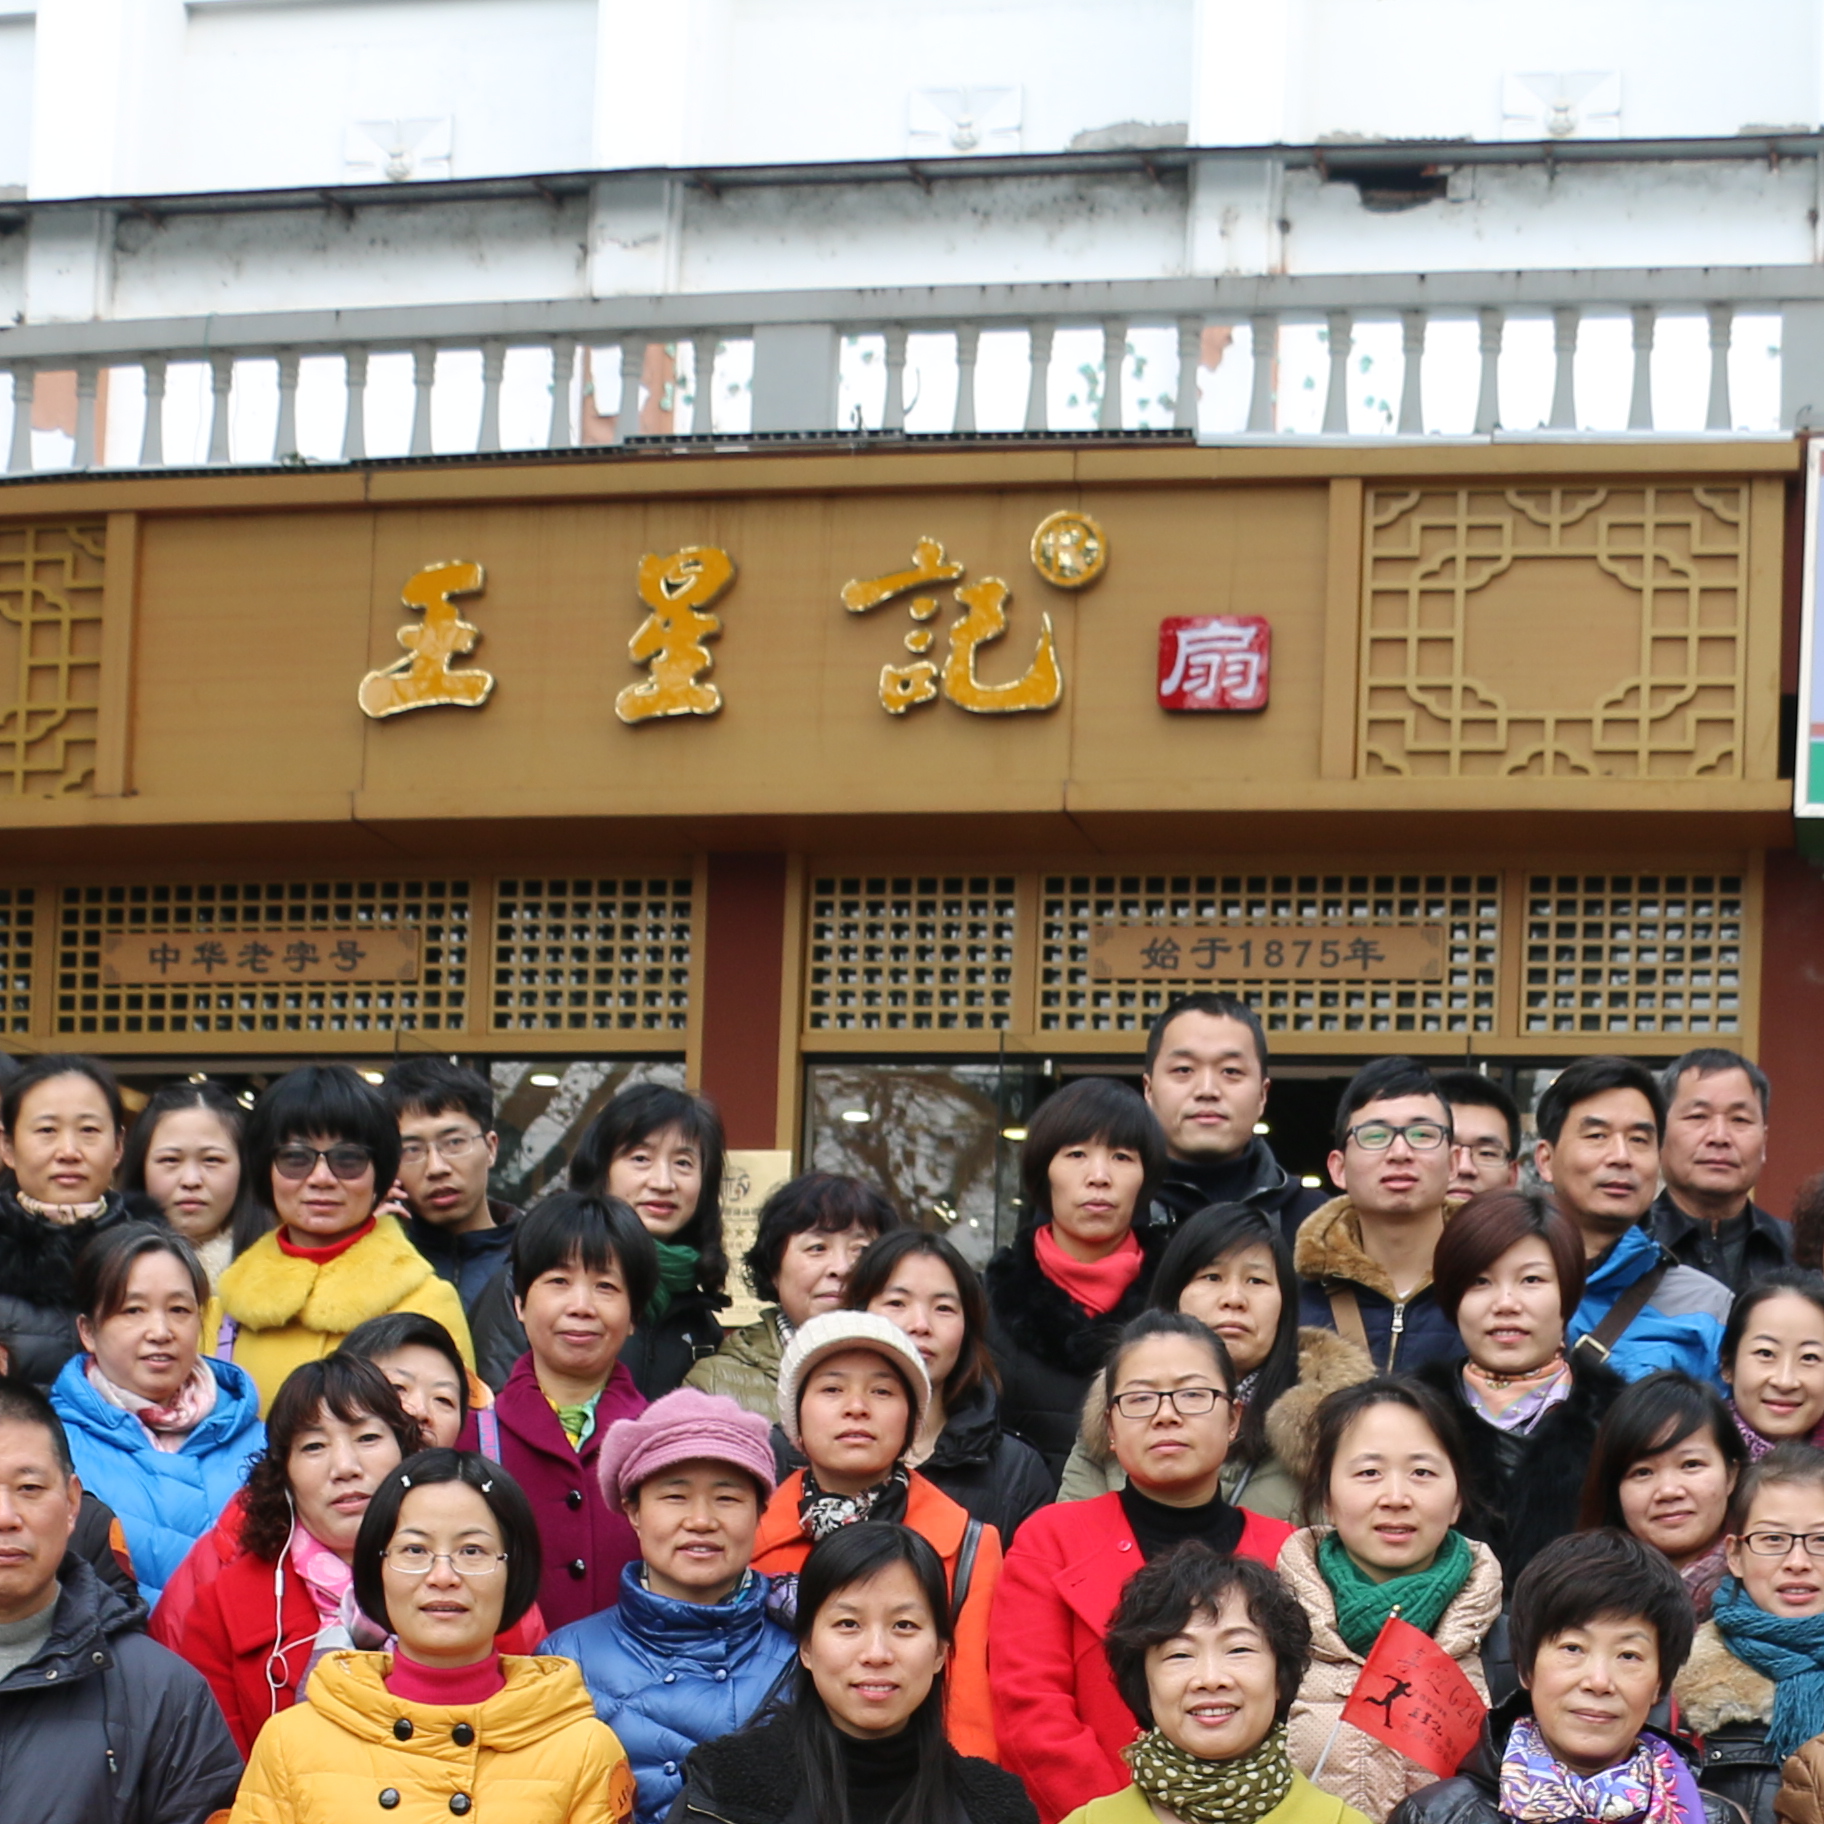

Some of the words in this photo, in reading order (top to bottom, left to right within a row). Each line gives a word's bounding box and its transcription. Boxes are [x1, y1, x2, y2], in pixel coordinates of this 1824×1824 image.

[1162, 624, 1264, 701] 扇
[148, 940, 367, 975] 中华老字号
[1140, 936, 1386, 970] 始于1875年
